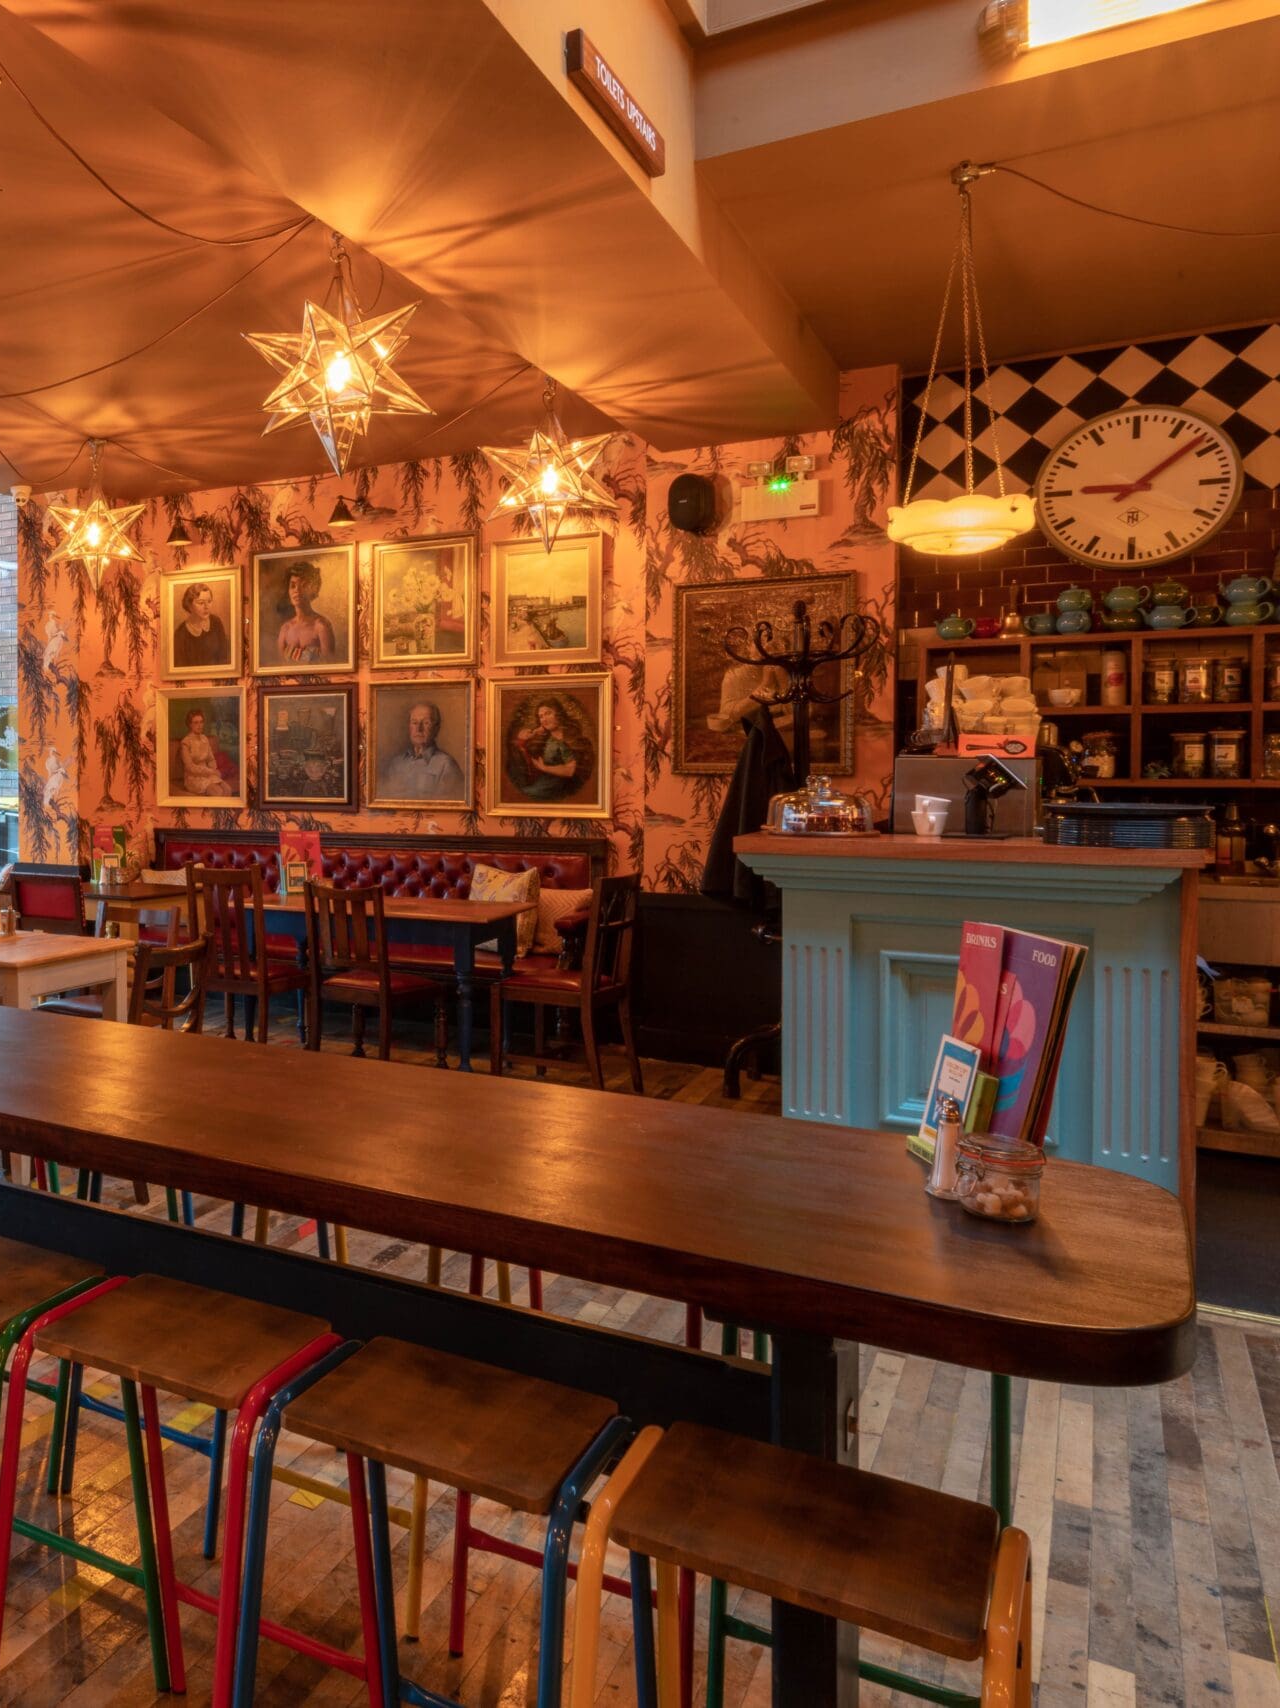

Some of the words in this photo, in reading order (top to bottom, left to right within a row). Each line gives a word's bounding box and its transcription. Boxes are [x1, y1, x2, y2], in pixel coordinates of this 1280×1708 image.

[594, 56, 626, 110] TOILETS
[626, 97, 657, 151] UPSTAIRS
[965, 932, 998, 949] DRINKS
[1031, 949, 1058, 967] FOOD
